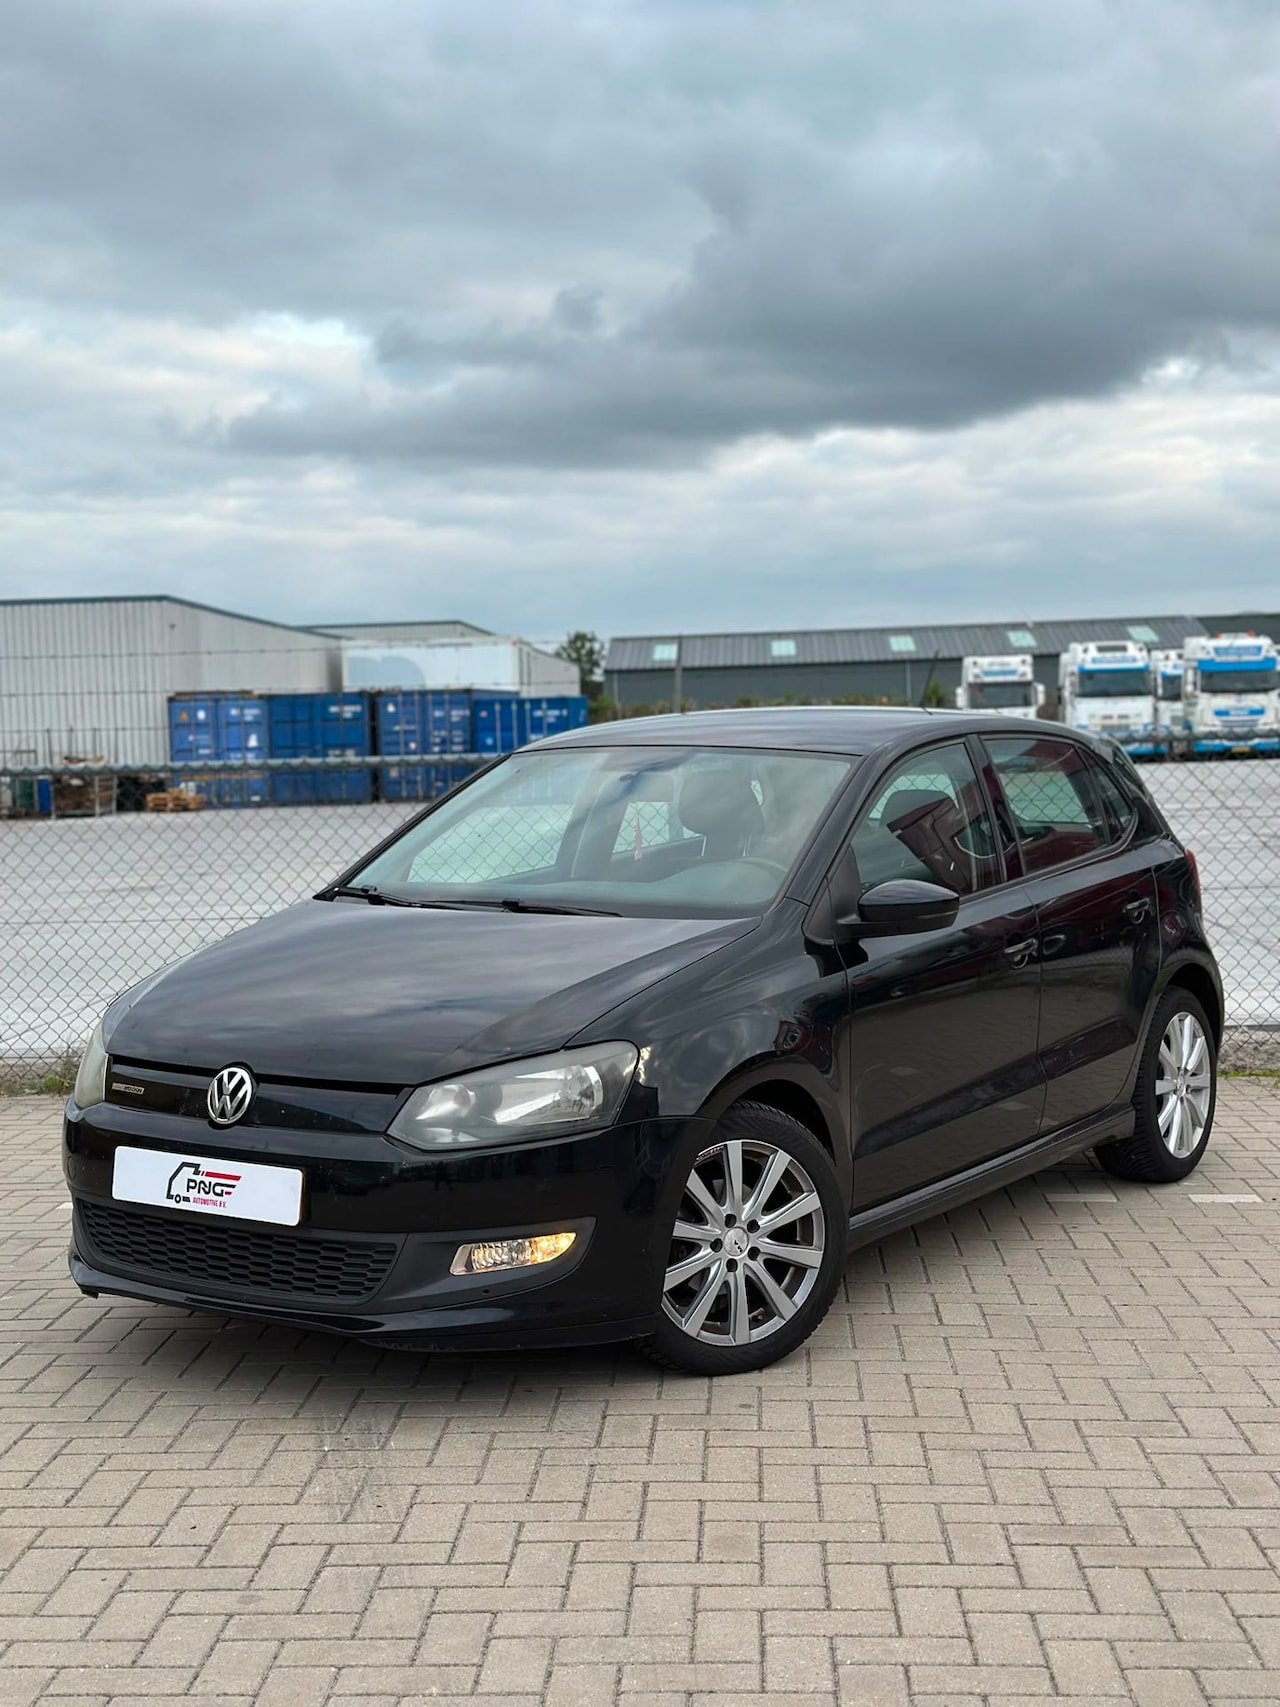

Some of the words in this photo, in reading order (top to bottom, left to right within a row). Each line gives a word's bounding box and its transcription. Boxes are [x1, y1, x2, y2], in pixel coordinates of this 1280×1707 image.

[207, 1066, 252, 1125] VW
[186, 1178, 236, 1198] PNG
[192, 1197, 218, 1207] AUTOMOTIVE
